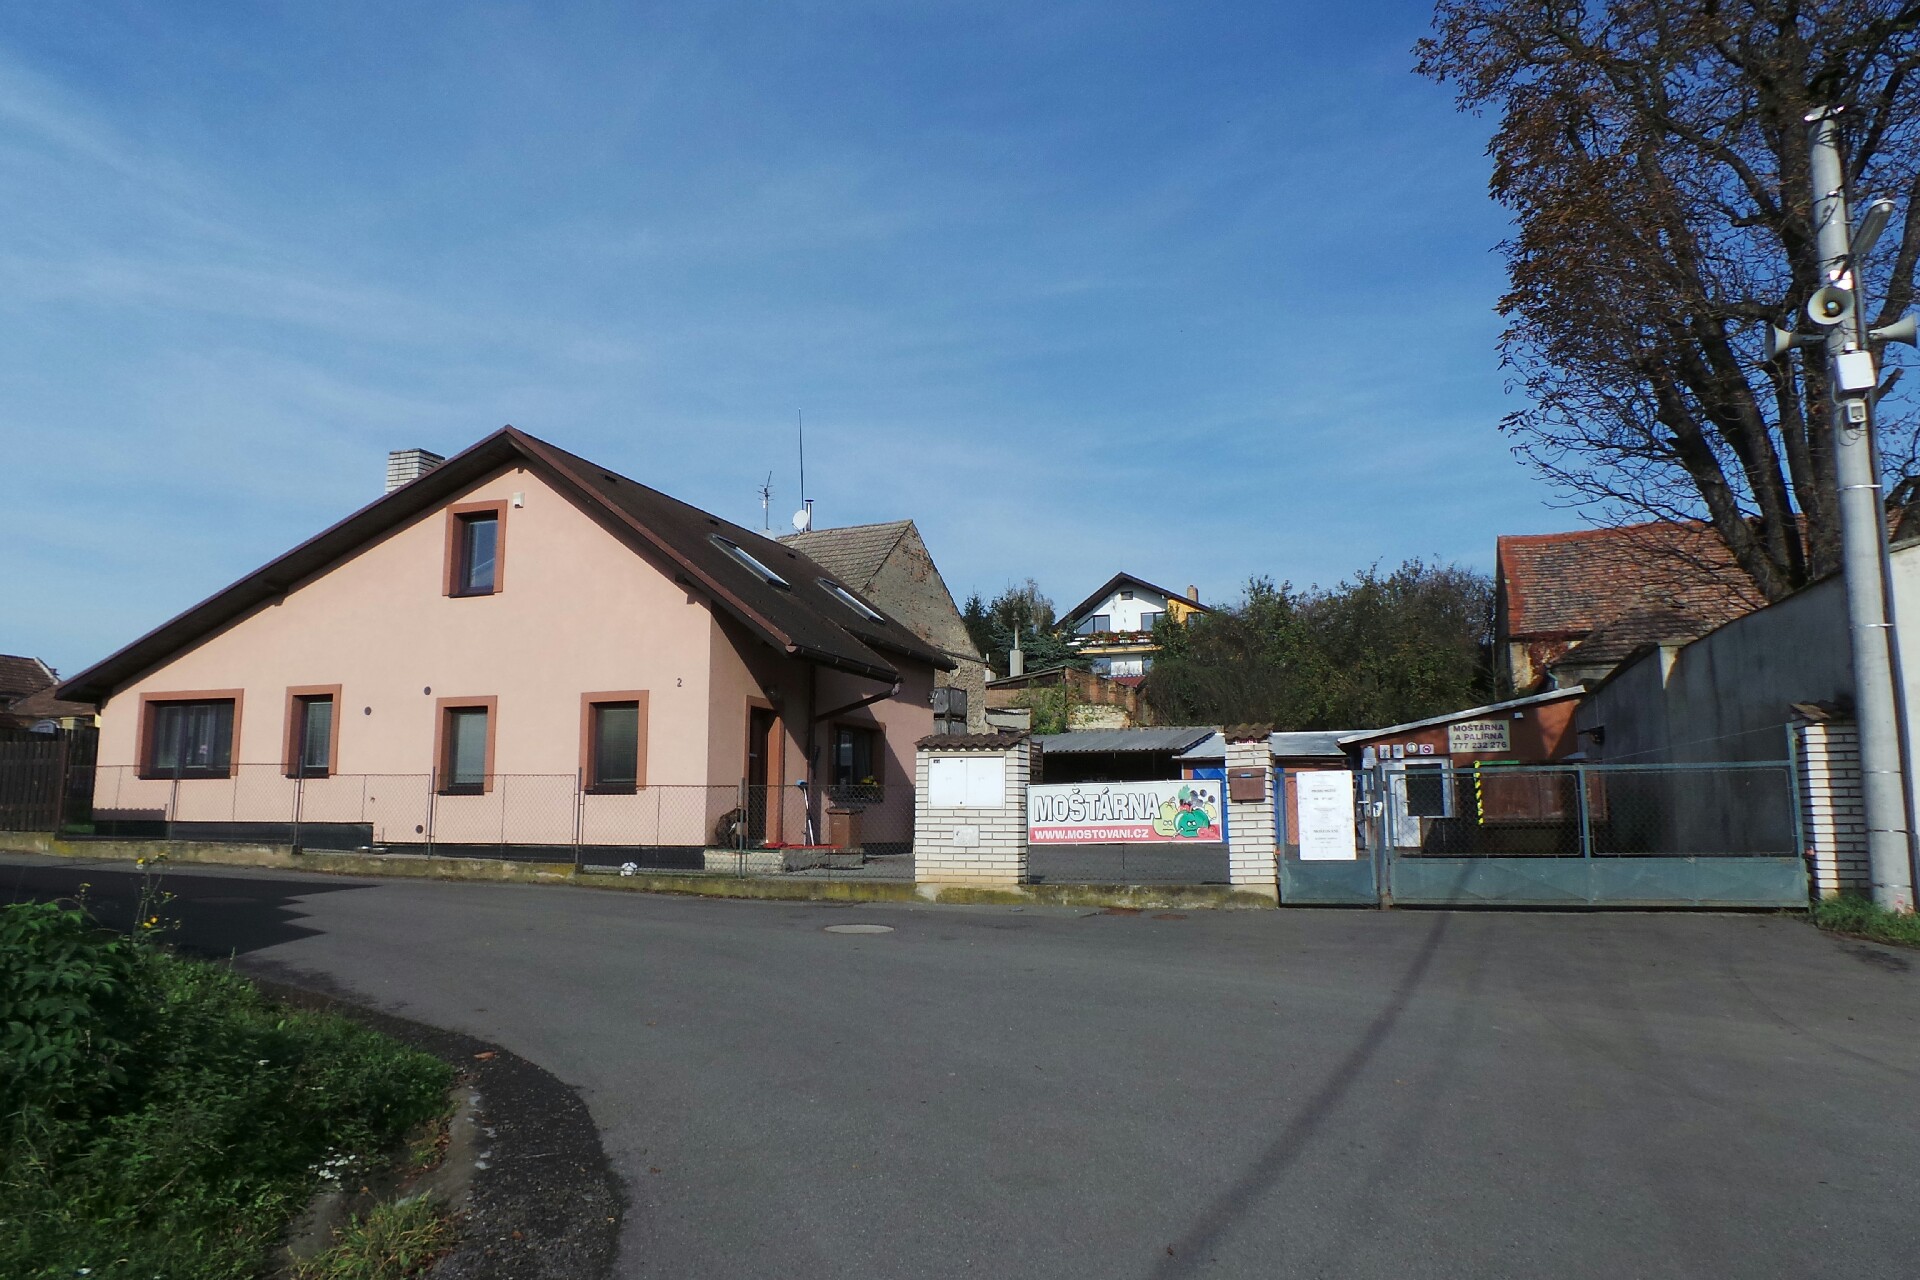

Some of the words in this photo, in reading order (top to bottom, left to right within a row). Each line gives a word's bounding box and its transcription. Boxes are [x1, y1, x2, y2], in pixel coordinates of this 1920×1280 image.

[676, 677, 683, 688] 2
[1453, 723, 1504, 732] MOŠTÁRNA
[1034, 787, 1161, 822] MOŠTÁRNA
[1035, 829, 1149, 840] WWW.MOSTOVANI.CZ
